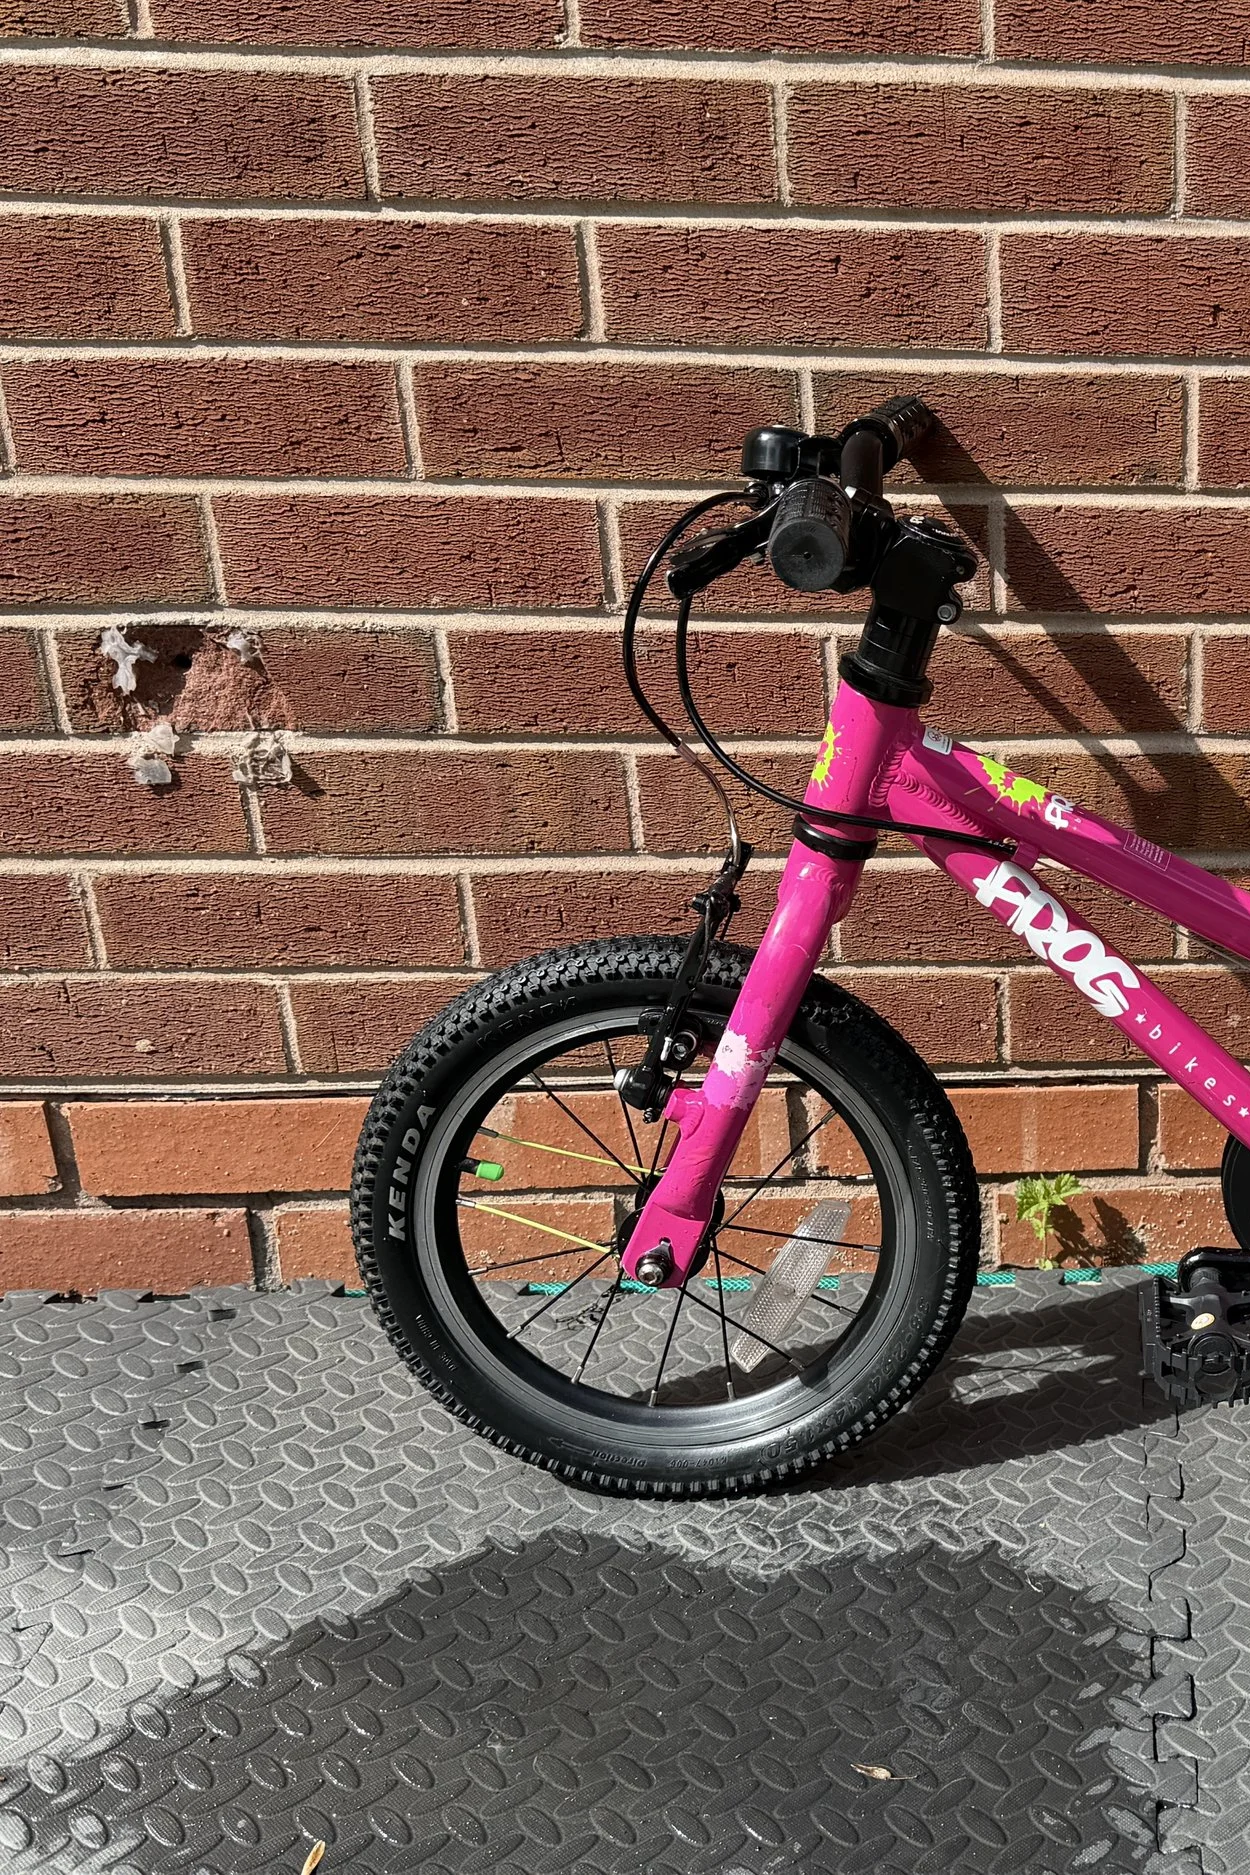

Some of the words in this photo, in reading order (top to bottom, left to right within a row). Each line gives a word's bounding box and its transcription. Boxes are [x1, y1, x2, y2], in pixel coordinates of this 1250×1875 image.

[972, 860, 1141, 1018] FROG
[1148, 1023, 1237, 1107] bikes
[388, 1104, 437, 1242] KENDA
[592, 1449, 648, 1468] Direction
